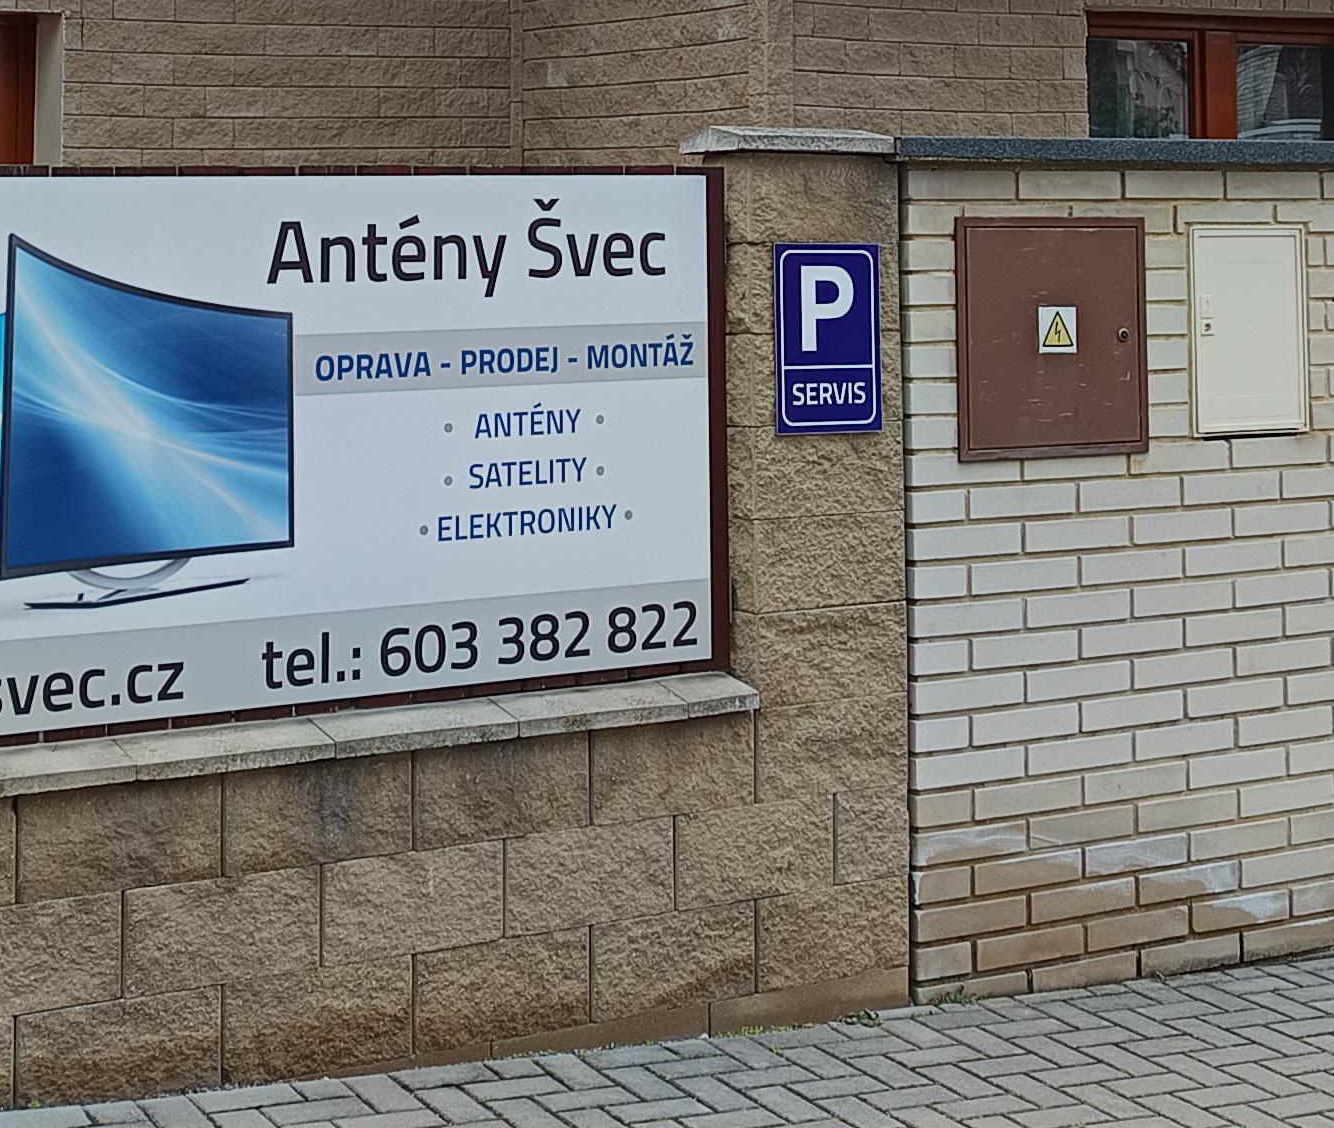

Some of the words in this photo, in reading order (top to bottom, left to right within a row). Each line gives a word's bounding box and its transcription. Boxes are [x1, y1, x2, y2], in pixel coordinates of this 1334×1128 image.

[266, 214, 508, 298] Antény
[527, 197, 667, 278] Švec
[801, 266, 854, 351] P
[315, 351, 431, 381] OPRAVA
[461, 346, 559, 374] PRODEJ
[587, 333, 694, 370] MONTÁŽ
[792, 383, 866, 405] SERVIS
[474, 402, 582, 440] ANTÉNY
[468, 457, 588, 490] SATELITY
[437, 504, 618, 543] ELEKTRONIKY
[261, 631, 362, 689] tel.:
[380, 621, 479, 677] 603
[497, 611, 591, 666] 382
[606, 600, 698, 655] 822
